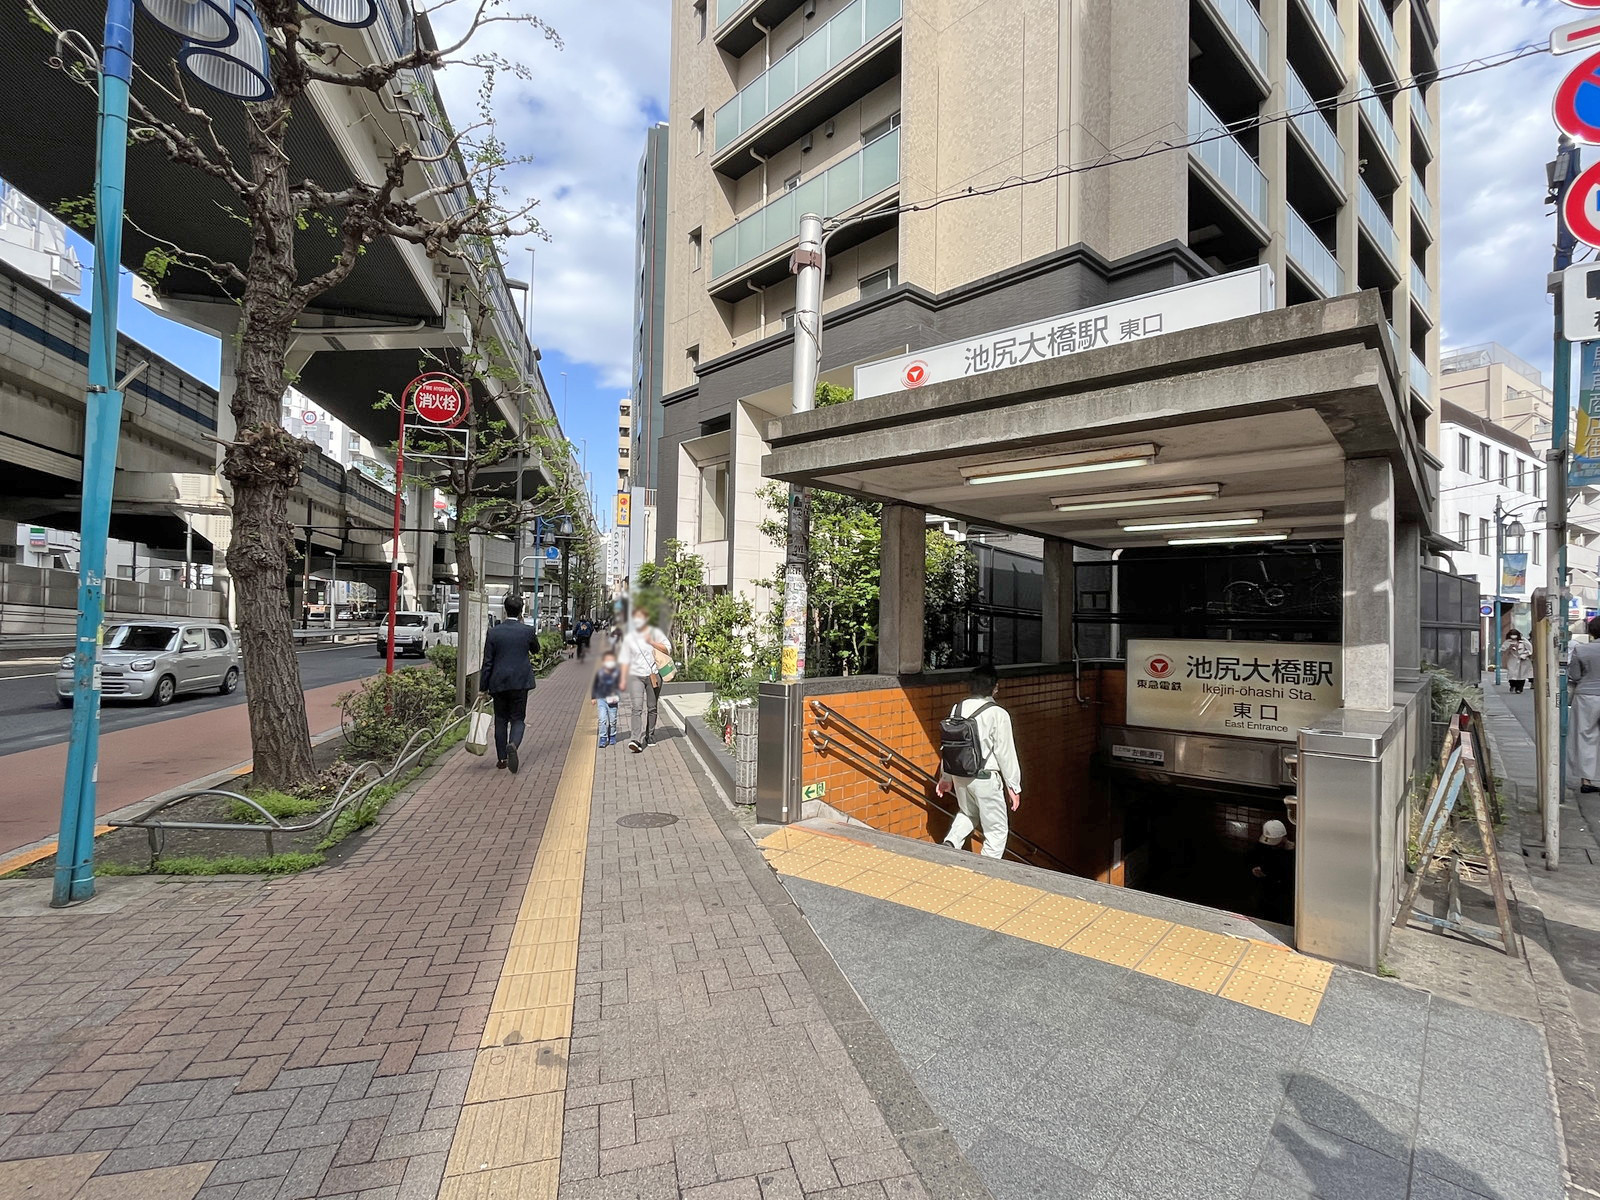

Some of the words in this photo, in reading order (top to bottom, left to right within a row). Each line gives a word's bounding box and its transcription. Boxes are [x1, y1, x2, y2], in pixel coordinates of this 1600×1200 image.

[964, 314, 1109, 375] 池尻大橋駅
[1119, 312, 1164, 341] 東口
[419, 392, 457, 411] 消火栓
[1186, 655, 1334, 687] 池尻大橋駅
[1137, 679, 1182, 692] 東急電鉄
[1288, 688, 1316, 701] Sta.
[1233, 702, 1278, 722] 東口
[1225, 719, 1244, 729] East
[1247, 721, 1289, 732] Entrance
